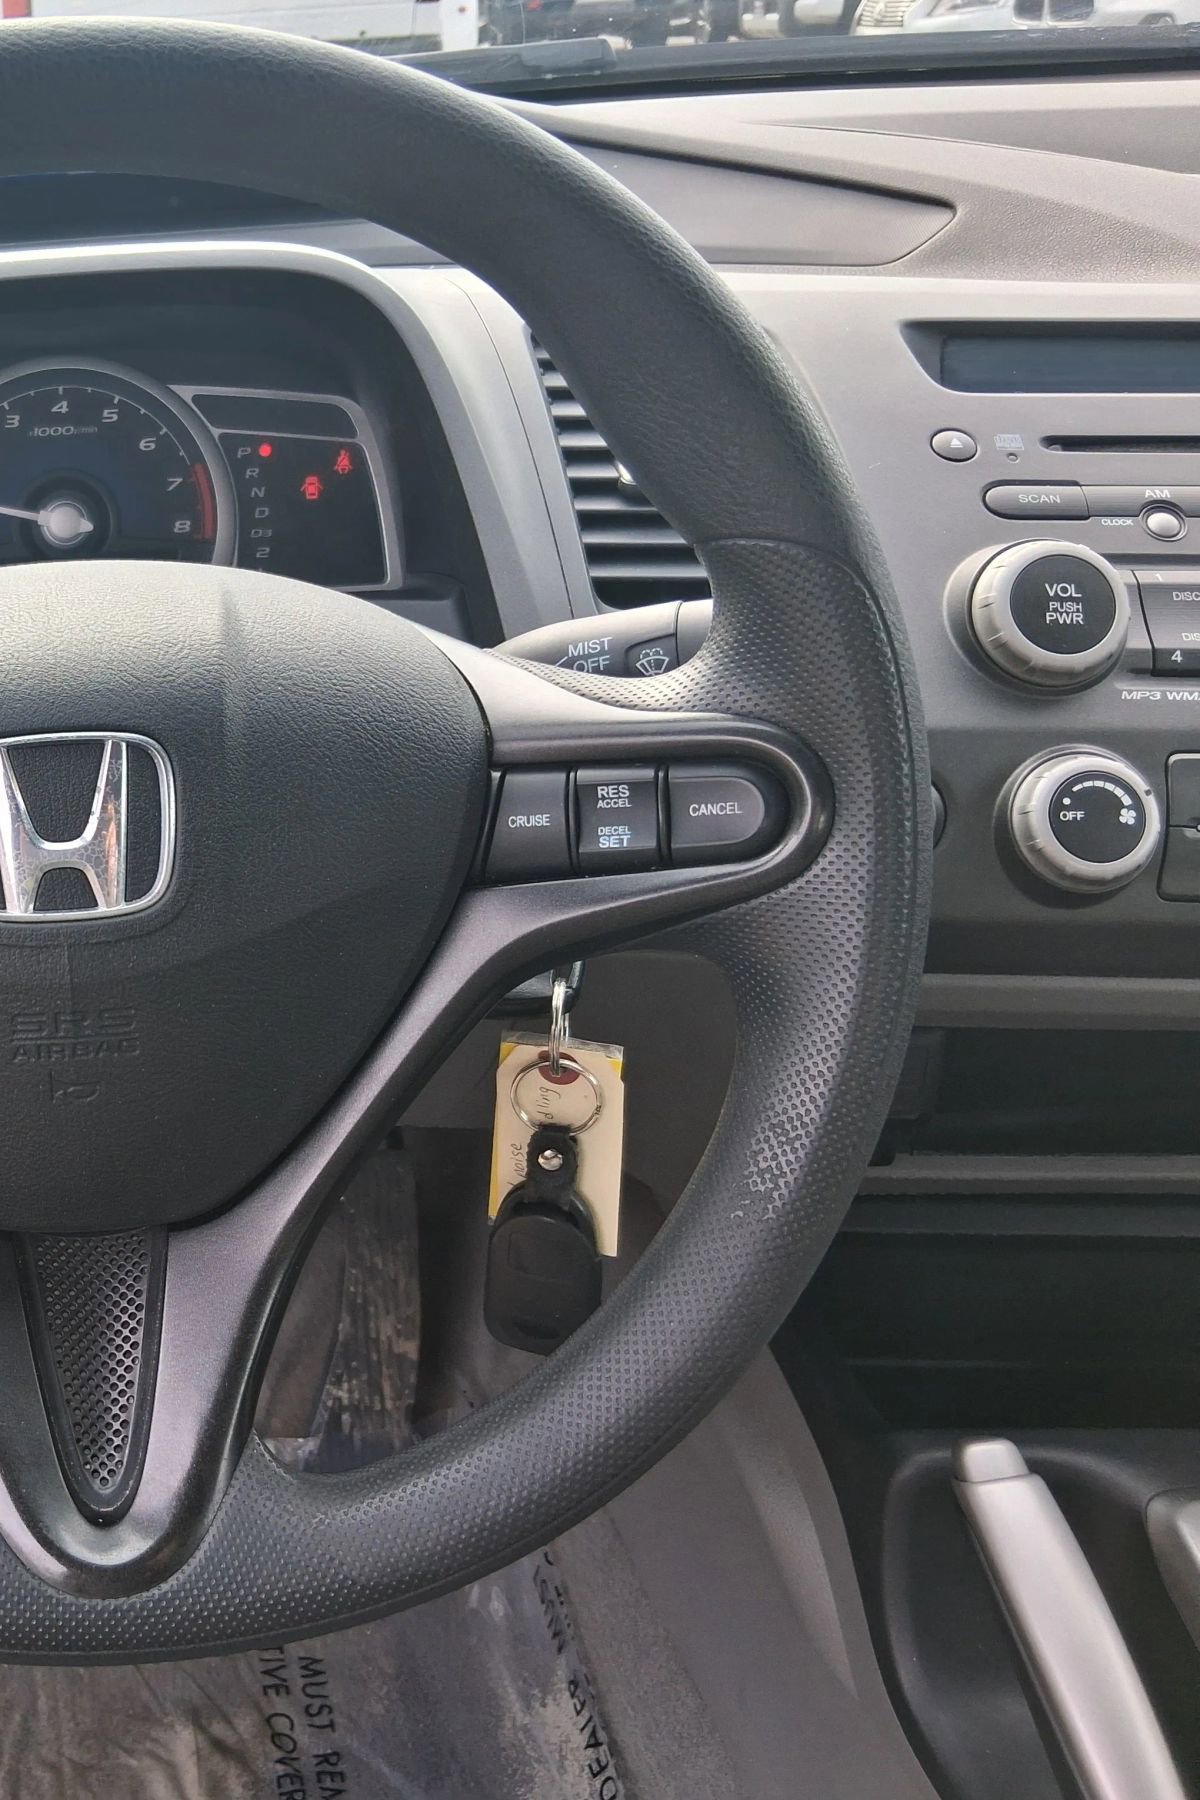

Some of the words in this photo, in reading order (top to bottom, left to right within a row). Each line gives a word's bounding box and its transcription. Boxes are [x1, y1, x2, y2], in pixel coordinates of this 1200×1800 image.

[51, 401, 69, 414] 4
[5, 415, 20, 428] 3
[102, 409, 119, 422] 5
[139, 437, 156, 451] 6
[237, 447, 251, 459] P
[245, 468, 259, 479] R
[167, 478, 183, 492] 7
[251, 486, 266, 498] N
[1144, 489, 1171, 498] AM
[1018, 494, 1061, 504] SCAN
[255, 507, 269, 518] D
[173, 520, 191, 533] 8
[1101, 518, 1133, 526] CLOCK
[256, 547, 270, 558] 2
[1045, 583, 1082, 597] VOL
[1049, 602, 1082, 612] PUSH
[1045, 612, 1084, 624] PWR
[568, 637, 613, 657] MIST
[1171, 650, 1183, 663] 4
[573, 655, 610, 673] OFF
[1121, 691, 1161, 701] MP3
[1166, 691, 1200, 701] WM
[597, 784, 630, 798] RES
[597, 798, 632, 809] ACCEL
[689, 802, 744, 817] CANCEL
[508, 814, 551, 828] CRUISE
[1059, 811, 1085, 821] OFF
[598, 825, 631, 835] DECEL
[598, 835, 631, 848] SET
[10, 1007, 137, 1038] SRS
[11, 1038, 140, 1062] AIRBAG
[298, 1656, 336, 1733] MUST
